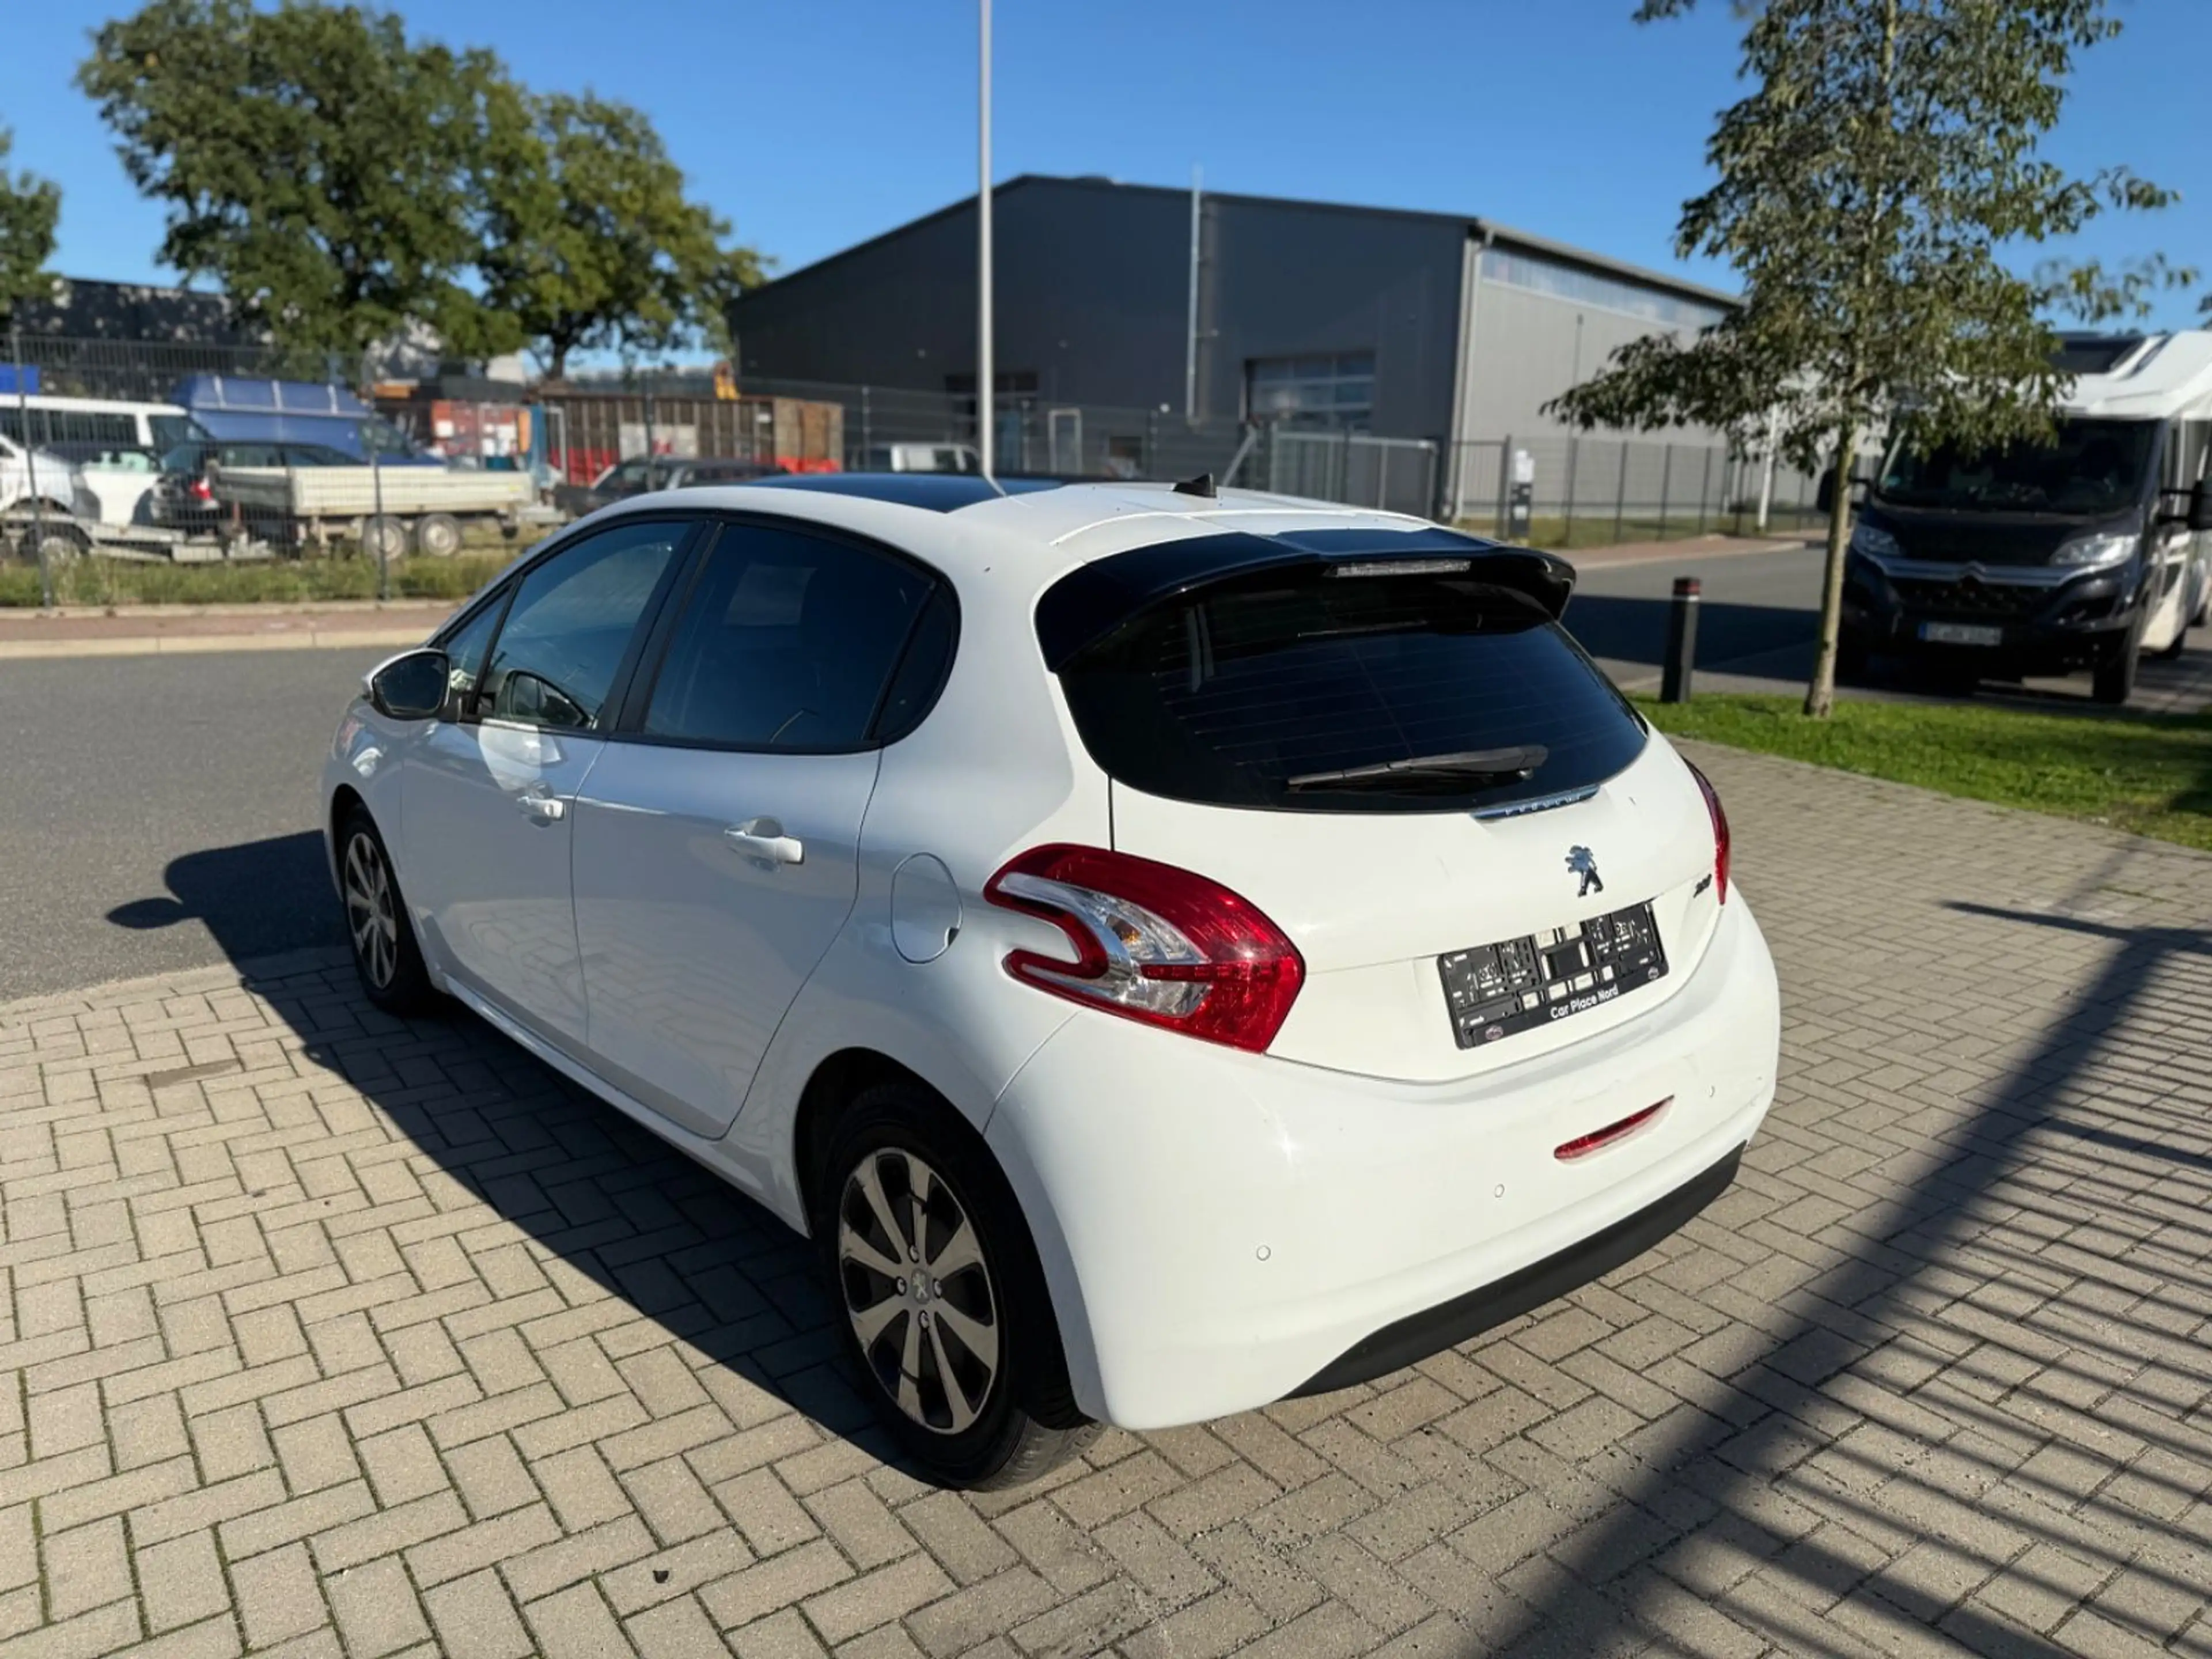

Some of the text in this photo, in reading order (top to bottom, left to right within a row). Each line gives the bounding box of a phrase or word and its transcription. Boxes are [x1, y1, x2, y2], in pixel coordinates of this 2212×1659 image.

[1550, 982, 1619, 1018] Car Place Nord
